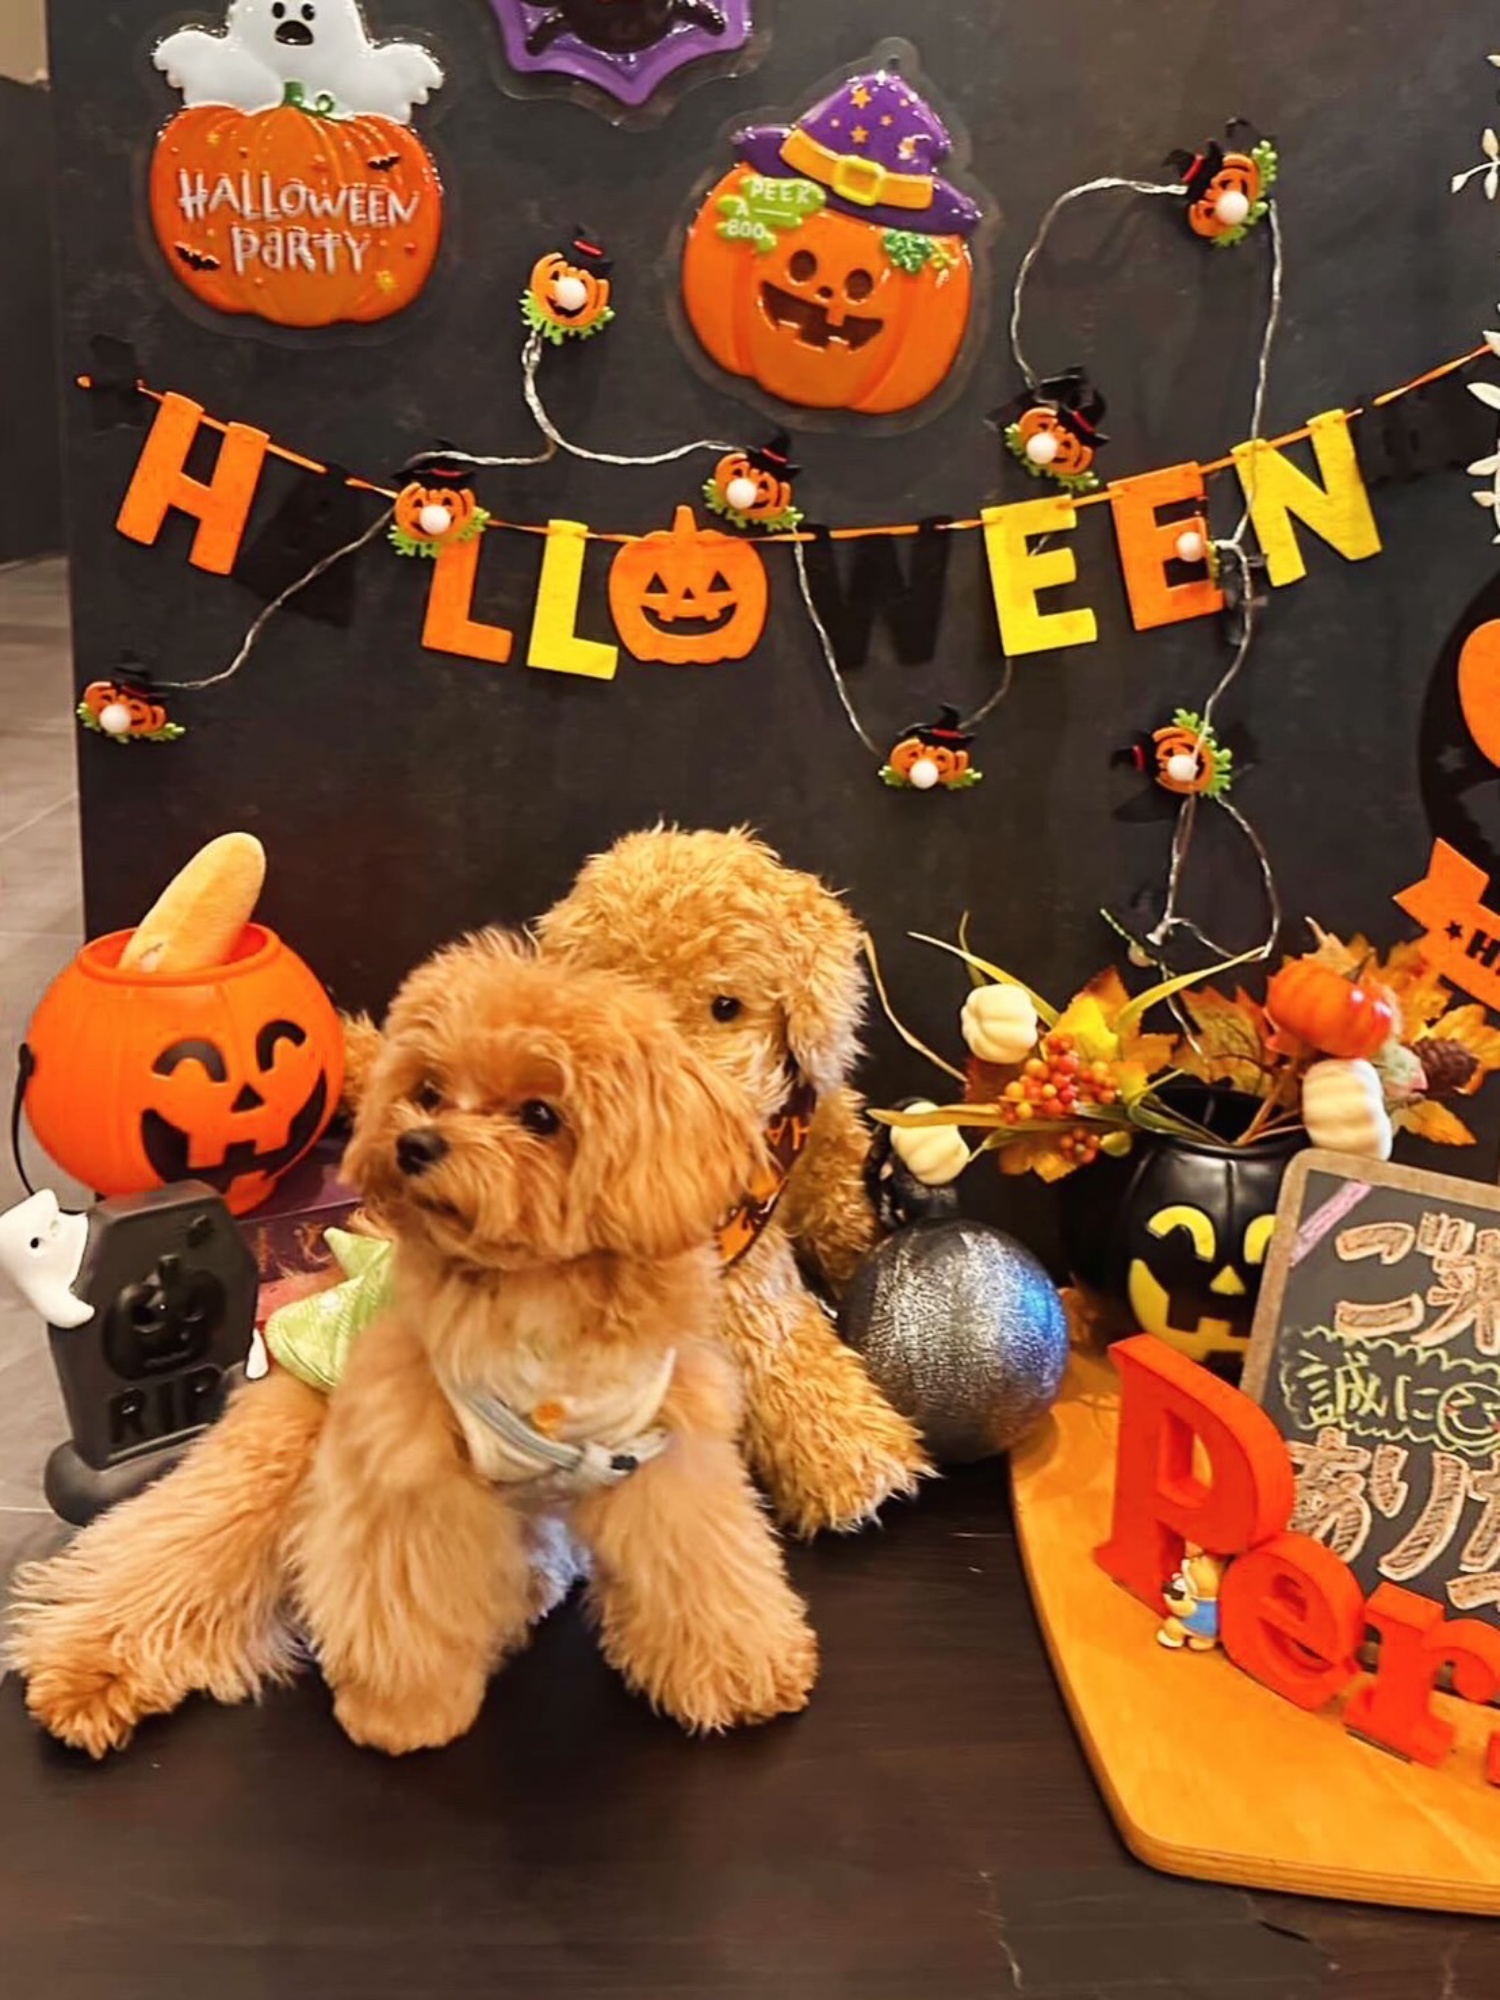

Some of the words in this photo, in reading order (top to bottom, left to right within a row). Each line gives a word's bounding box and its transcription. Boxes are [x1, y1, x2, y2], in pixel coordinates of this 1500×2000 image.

[177, 168, 421, 228] HALLOWEEN
[749, 177, 814, 204] PEEK
[726, 218, 767, 239] BOO
[109, 1366, 225, 1444] RIP
